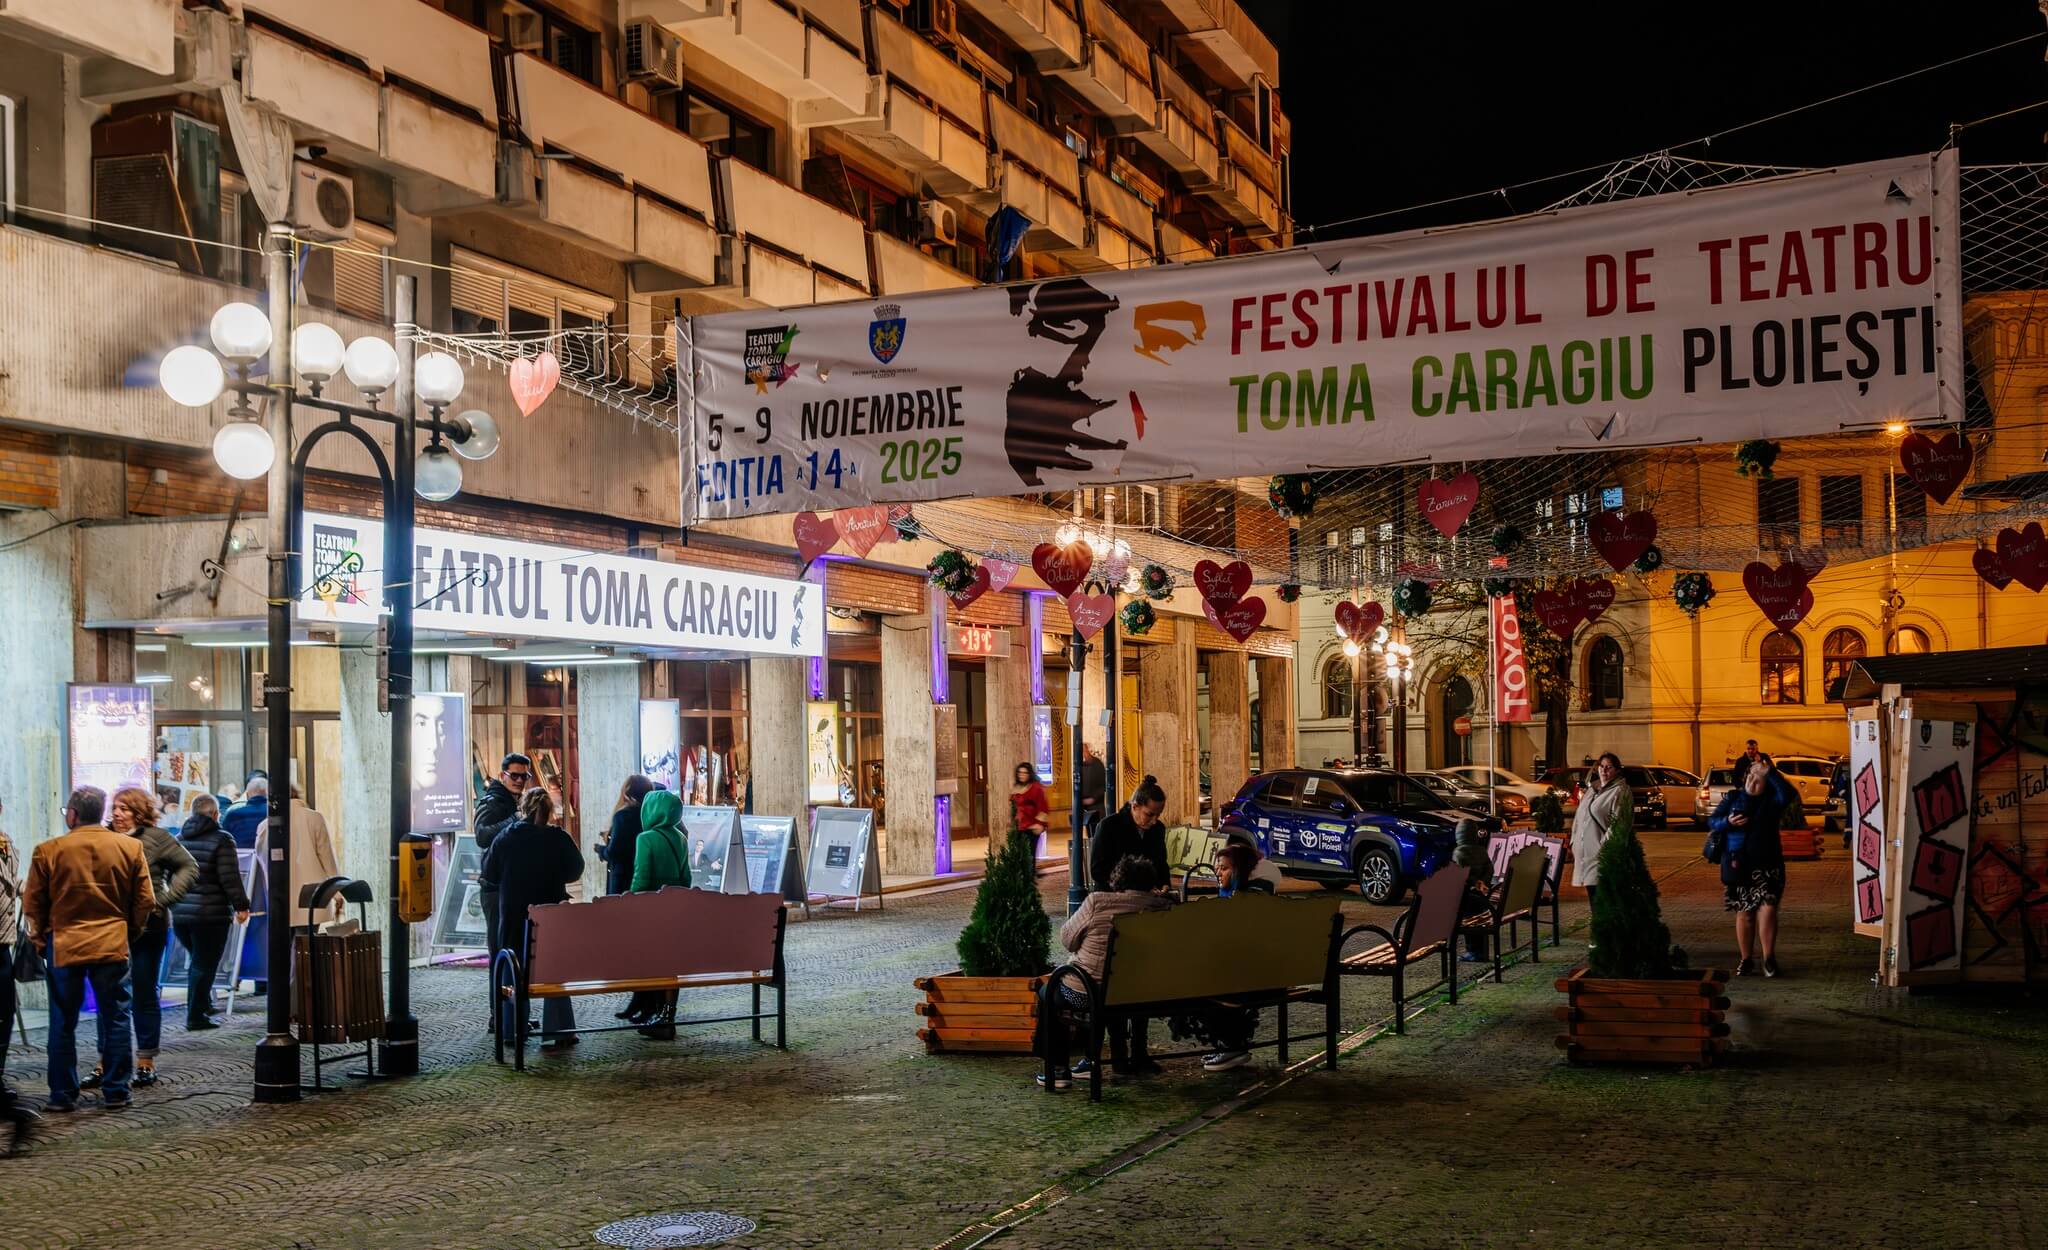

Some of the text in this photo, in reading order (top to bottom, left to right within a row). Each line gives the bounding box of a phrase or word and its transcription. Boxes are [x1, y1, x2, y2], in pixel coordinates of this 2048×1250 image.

[1231, 215, 1932, 355] FESTIVALUL DE TEATRU
[745, 354, 782, 367] CARAGIU
[747, 345, 773, 356] TOMA
[748, 332, 785, 346] TEATRUL
[1229, 305, 1936, 433] TOMA CARAGIU PLOIEȘTI
[708, 413, 724, 452] 5
[755, 406, 772, 444] 9
[800, 385, 966, 442] NOIEMBRIE
[697, 454, 784, 508] EDIȚIA
[879, 436, 965, 484] 2025
[315, 548, 342, 564] TOMA
[1202, 569, 1233, 586] Suflet
[415, 544, 777, 640] EATRUL TOMA CARAGIU
[1501, 596, 1528, 714] TOYOT
[1321, 832, 1341, 843] Toyota
